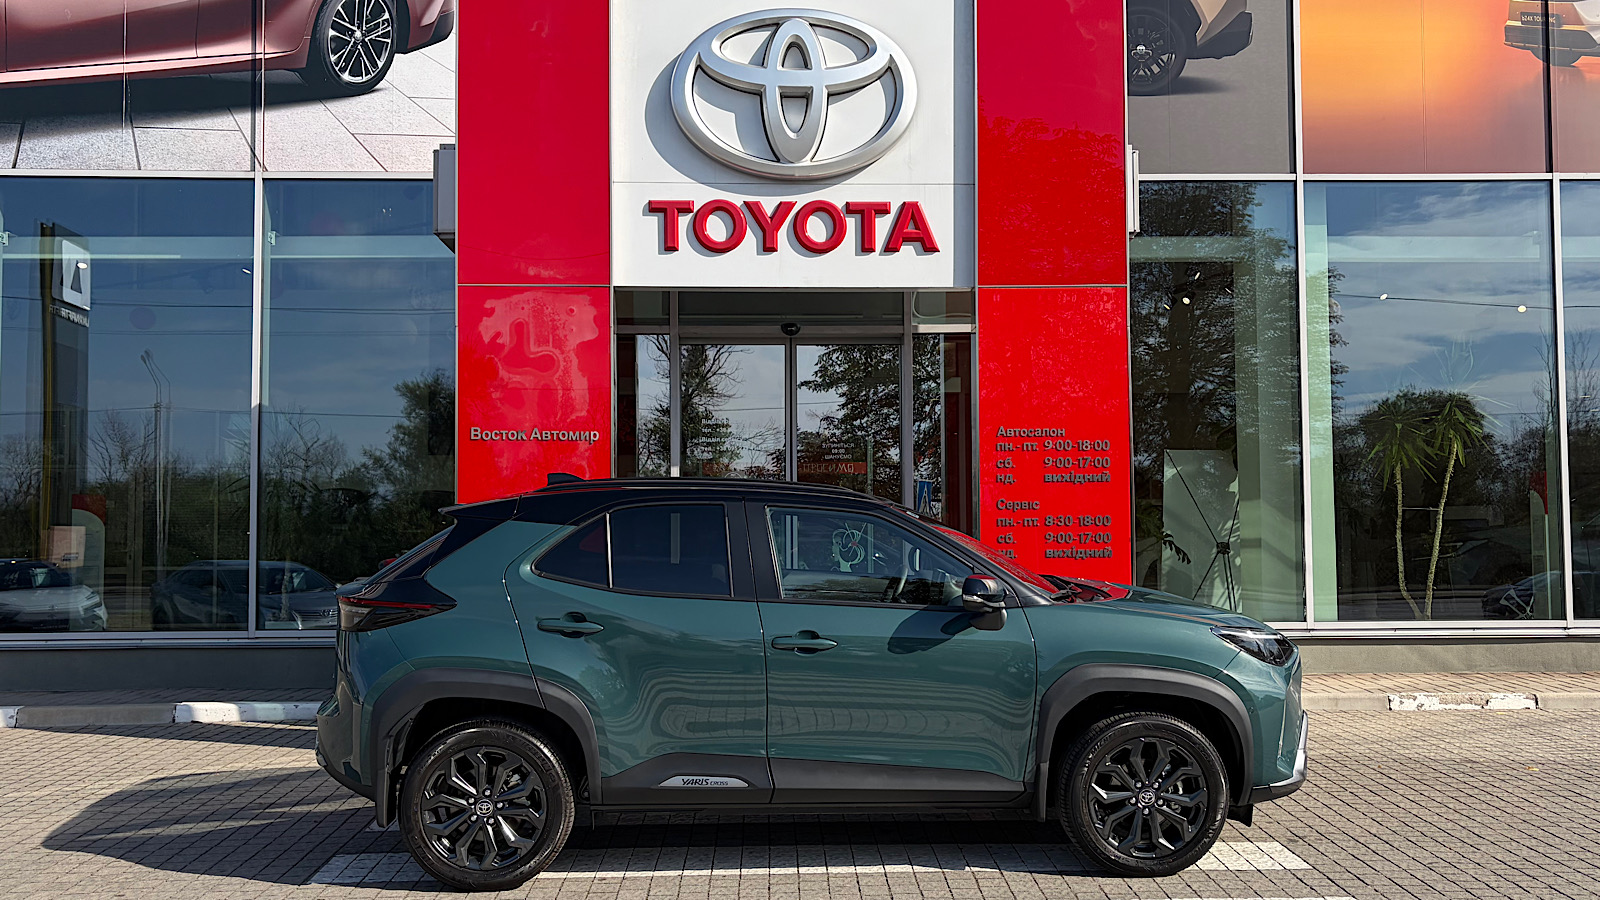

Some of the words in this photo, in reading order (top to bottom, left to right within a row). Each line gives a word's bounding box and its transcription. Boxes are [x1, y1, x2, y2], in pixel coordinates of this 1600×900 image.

[648, 199, 940, 254] TOYOTA
[470, 427, 527, 440] Восток
[530, 428, 600, 444] Автомир
[997, 426, 1065, 437] Автосалон
[1044, 440, 1111, 451] 9:00-18:00
[997, 457, 1016, 468] сб.
[1044, 456, 1111, 468] 9:00-17:00
[997, 473, 1017, 484] нд.
[1044, 471, 1111, 484] вихідний
[997, 498, 1040, 512] Сервіс
[1045, 515, 1112, 526] 8:30-18:00
[998, 532, 1017, 544] сб.
[1045, 532, 1112, 544] 9:00-17:00
[1045, 546, 1113, 559] вихідний
[681, 778, 710, 786] YARIS
